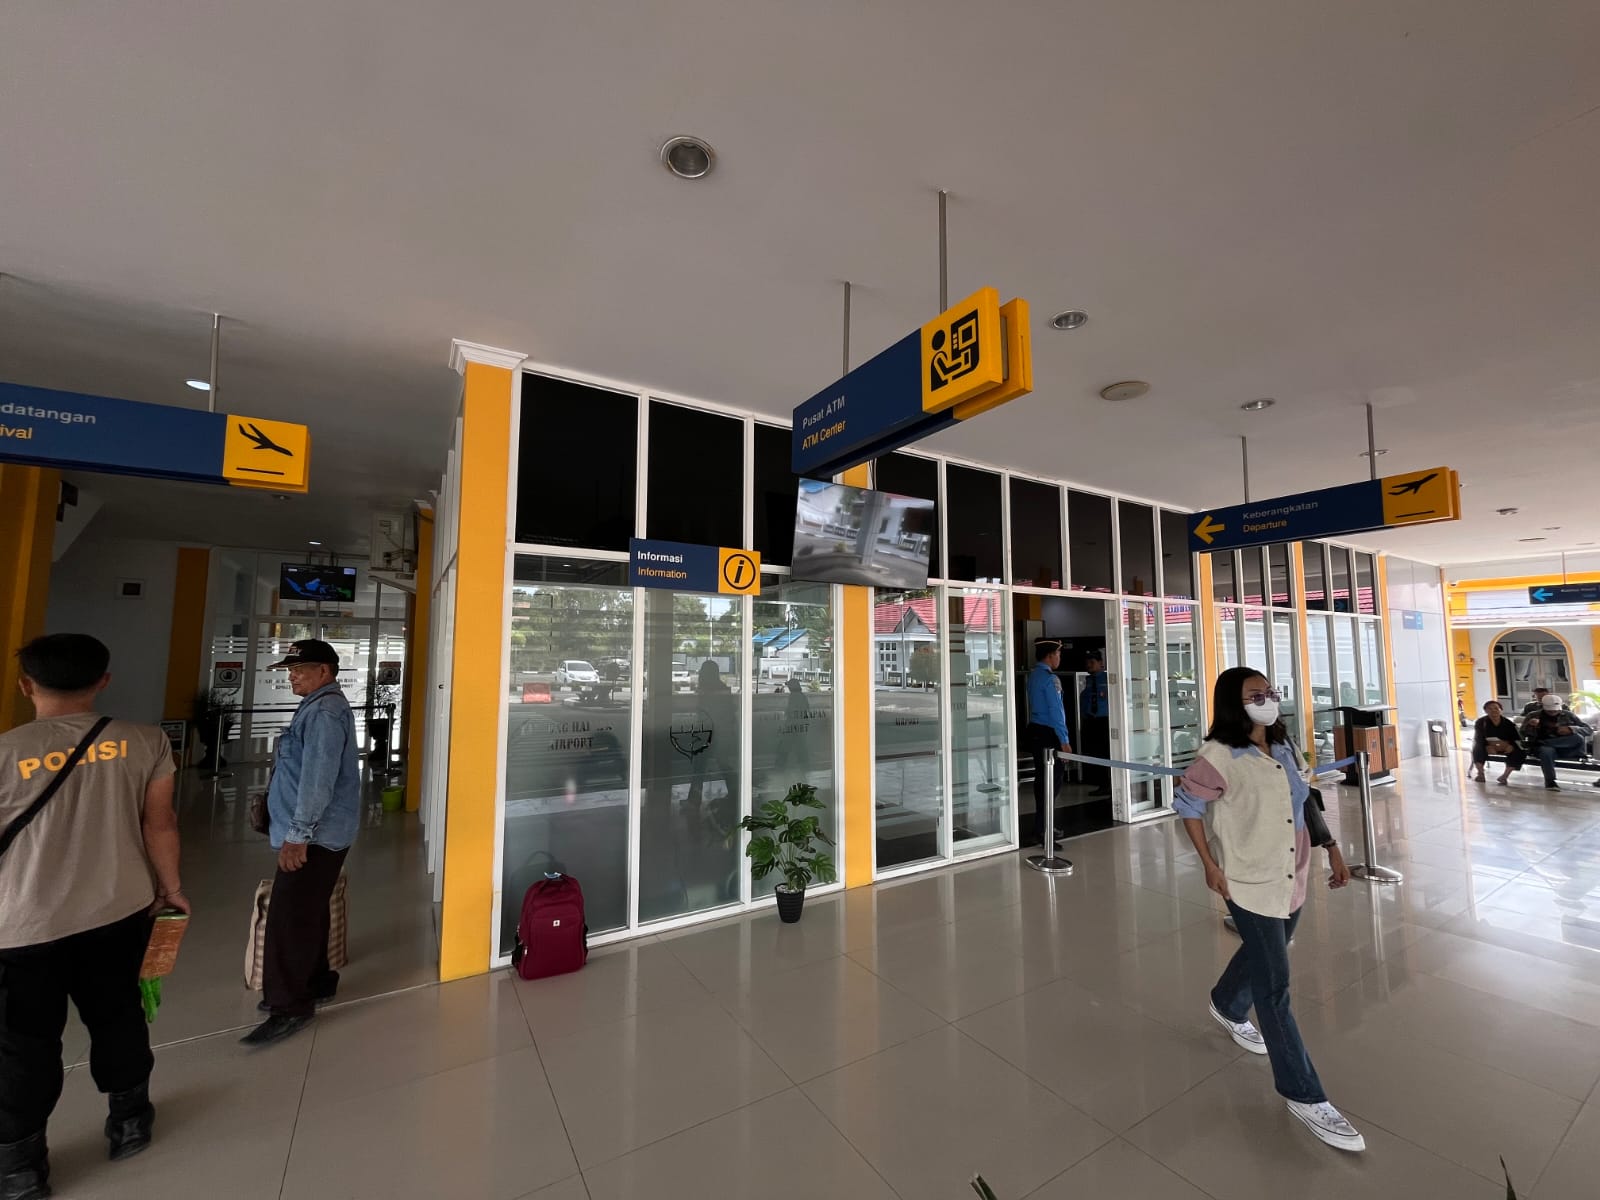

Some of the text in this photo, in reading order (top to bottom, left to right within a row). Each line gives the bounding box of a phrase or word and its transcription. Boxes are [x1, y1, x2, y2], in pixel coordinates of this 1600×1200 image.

[0, 402, 97, 425] datangan
[802, 395, 846, 430] Pusat ATM
[0, 423, 33, 440] ival
[802, 420, 847, 451] ATM Center
[1242, 502, 1319, 520] Keberangkatan
[1242, 519, 1288, 533] Departure
[637, 550, 684, 564] Informasi
[637, 566, 688, 580] Information
